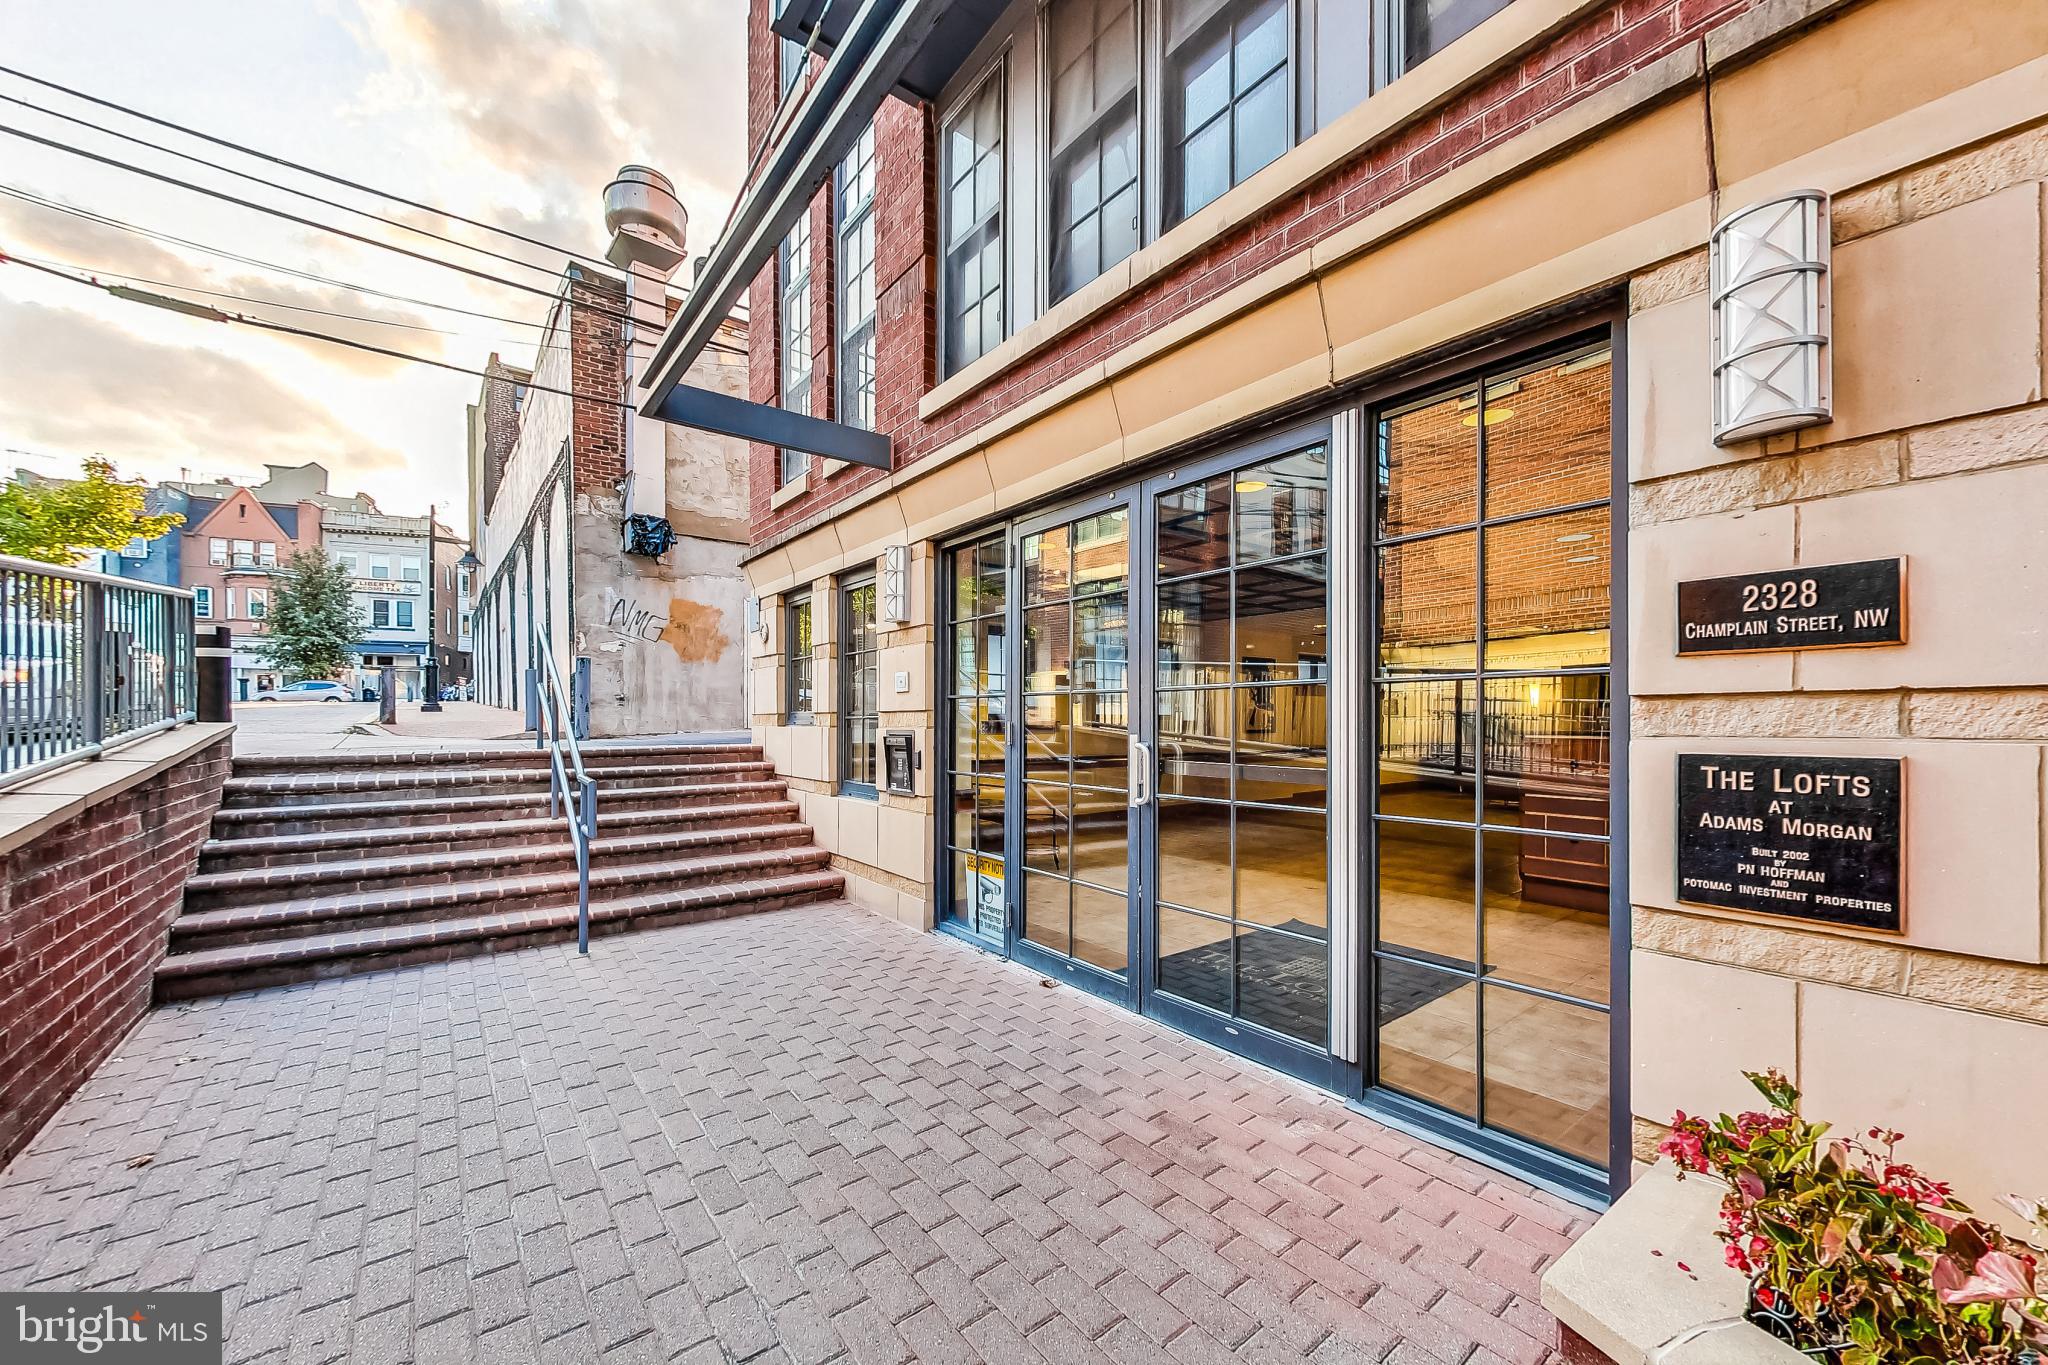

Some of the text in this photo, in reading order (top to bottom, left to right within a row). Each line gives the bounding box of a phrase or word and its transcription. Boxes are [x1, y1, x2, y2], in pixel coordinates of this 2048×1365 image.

[359, 580, 396, 588] LIBERTY
[1742, 579, 1818, 612] 2328
[608, 598, 668, 642] NMG
[1685, 608, 1890, 640] CHAMPLAIN STREET, NW
[1700, 765, 1871, 798] THE LOFTS
[1768, 800, 1794, 814] AT
[1700, 812, 1872, 842] ADAMS MORGAN
[968, 856, 1004, 876] SECRITY NOTI
[1752, 847, 1810, 861] BUILT 2002
[1737, 862, 1826, 883] PN HOFFMAN
[1770, 879, 1790, 888] AND
[1683, 877, 1893, 913] POTOMAC INVESTMENT PROPERTIES
